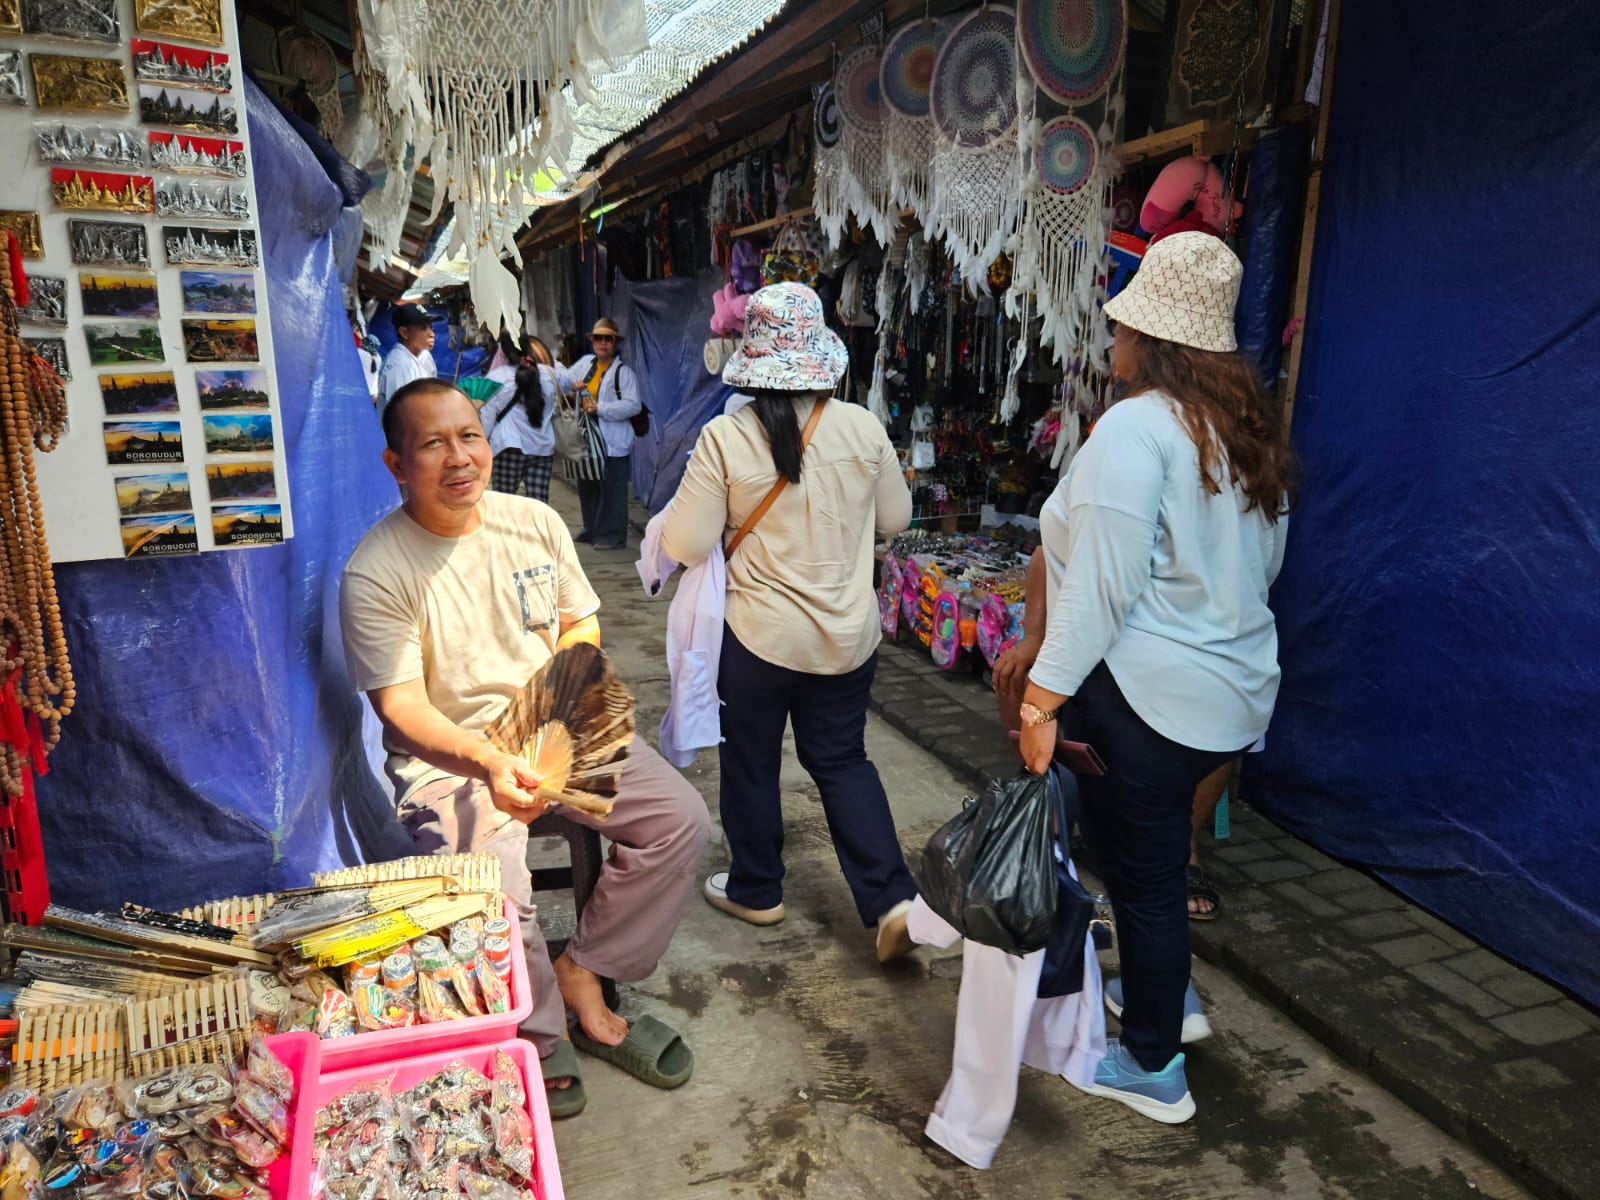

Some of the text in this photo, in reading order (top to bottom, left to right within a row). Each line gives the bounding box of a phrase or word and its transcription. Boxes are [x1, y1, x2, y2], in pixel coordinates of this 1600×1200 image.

[126, 451, 182, 459] BOROBUDUR
[231, 532, 281, 540] BOROBUDUR
[142, 543, 196, 552] BOROBUDUR
